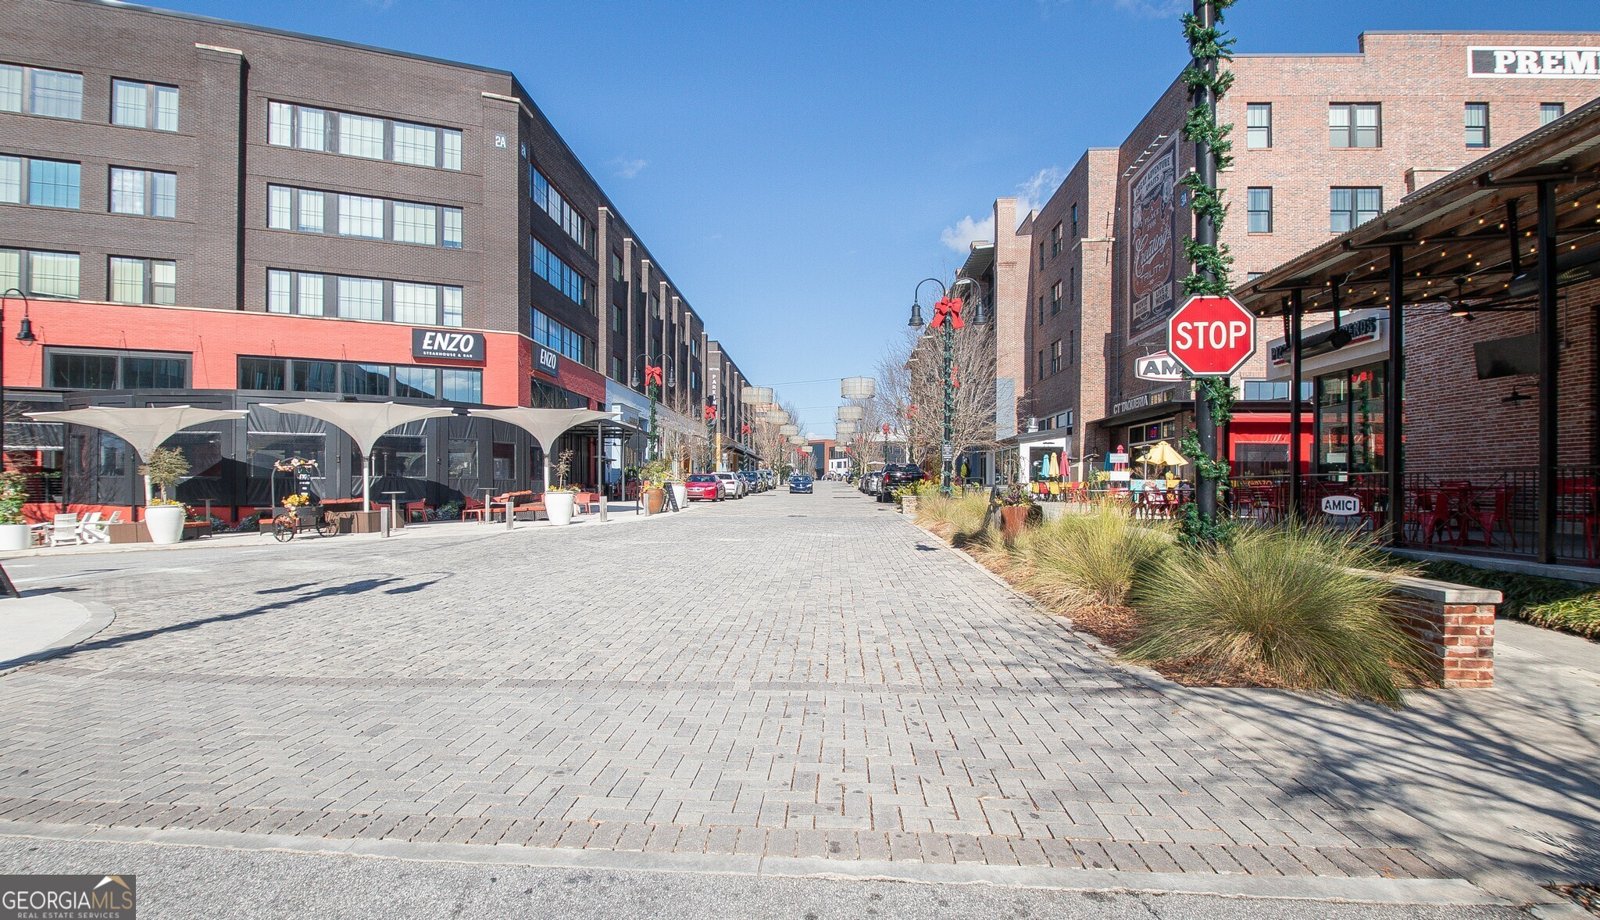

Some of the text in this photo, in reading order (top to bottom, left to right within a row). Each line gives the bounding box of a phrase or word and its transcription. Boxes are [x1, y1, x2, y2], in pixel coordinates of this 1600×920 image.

[1493, 50, 1600, 74] PREM
[495, 135, 506, 148] 2A
[422, 332, 474, 352] ENZO
[1175, 321, 1247, 350] STOP
[540, 348, 557, 370] ENZO
[1142, 360, 1182, 375] AM
[1113, 395, 1148, 415] CT TAQUERIA
[1324, 499, 1357, 512] AMICI
